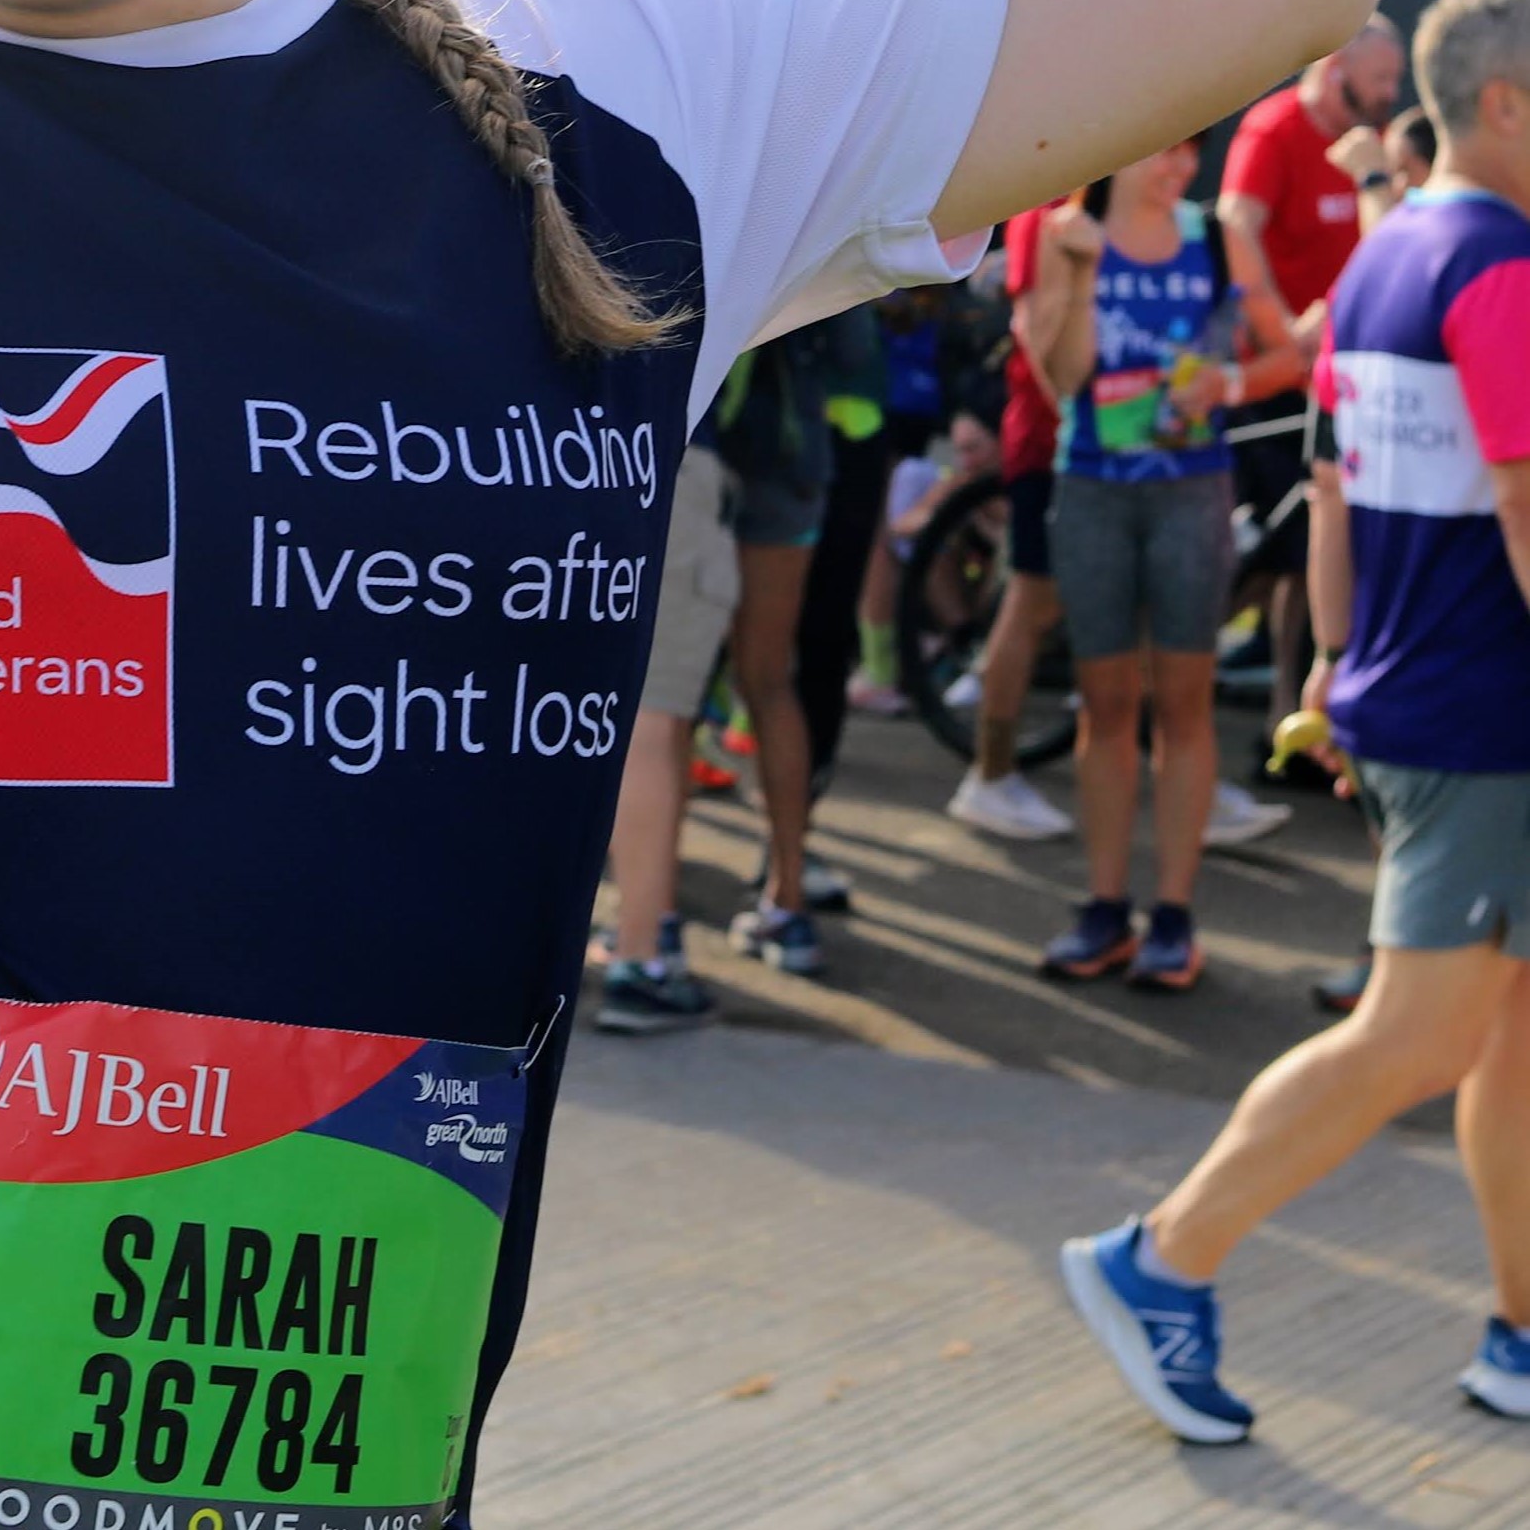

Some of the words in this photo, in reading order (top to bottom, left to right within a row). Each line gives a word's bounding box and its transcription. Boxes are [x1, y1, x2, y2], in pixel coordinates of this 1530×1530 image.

[243, 398, 657, 510] Rebuilding
[250, 515, 475, 618] lives
[501, 531, 648, 621] after
[244, 657, 487, 777] sight
[509, 663, 618, 758] loss
[425, 1121, 465, 1147] great
[472, 1122, 508, 1144] north
[93, 1215, 378, 1356] SARAH
[70, 1353, 366, 1494] 36784
